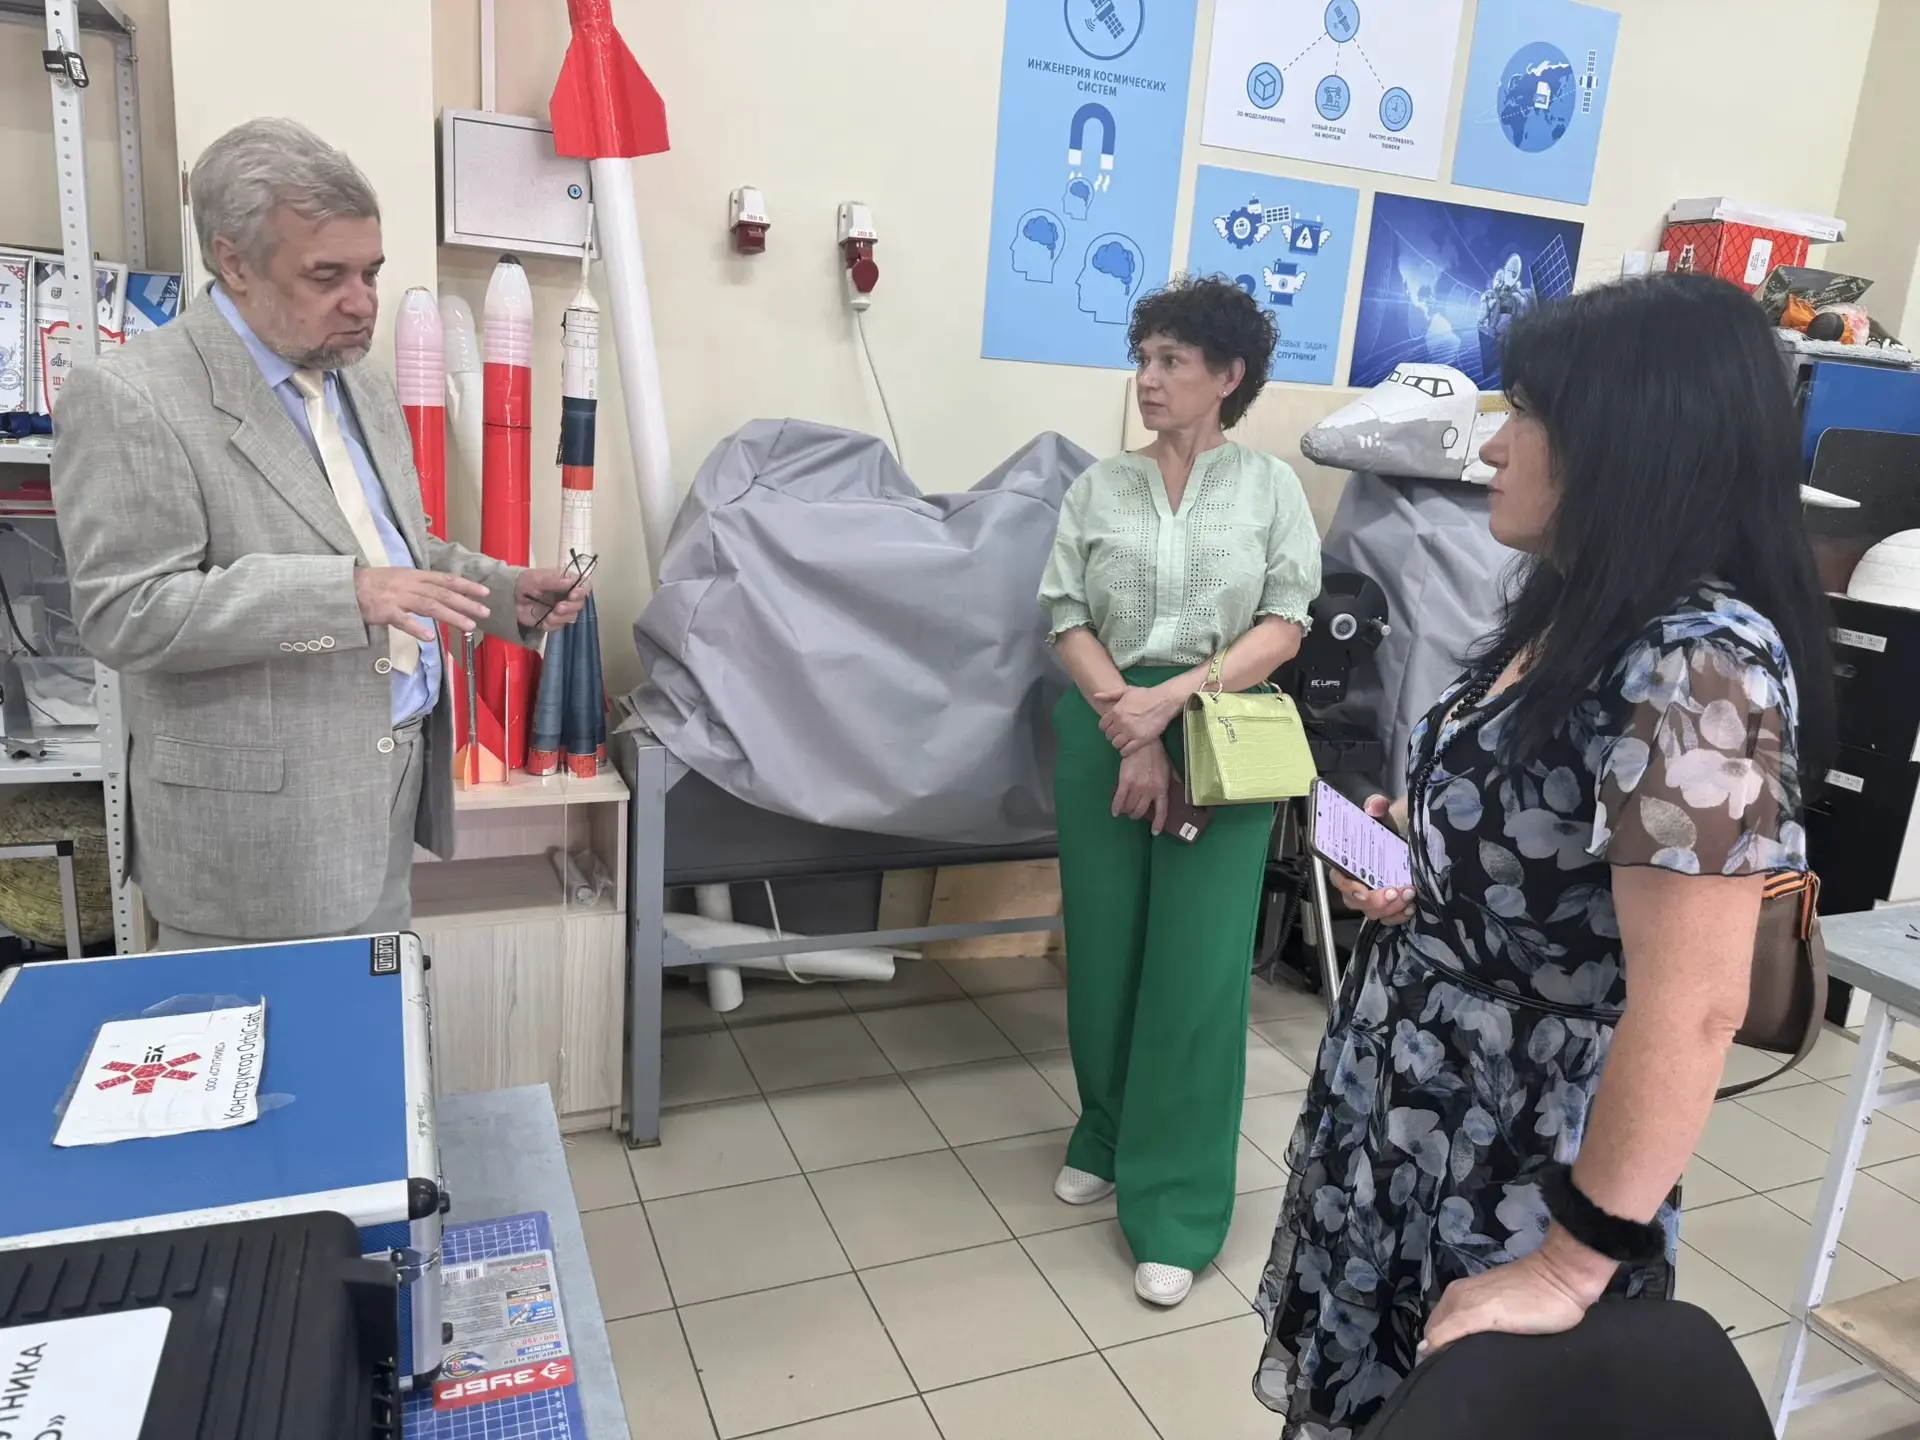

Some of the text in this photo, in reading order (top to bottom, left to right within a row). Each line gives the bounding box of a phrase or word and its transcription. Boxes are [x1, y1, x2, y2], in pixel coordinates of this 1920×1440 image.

[1027, 58, 1167, 92] ИНЖЕНЕРИЯ КОСМИЧЕСКИХ
[1077, 80, 1117, 97] СИСТЕМ
[1277, 351, 1316, 361] СПУТНИКИ
[375, 939, 396, 969] unipro
[223, 1009, 262, 1120] Конструктор OrbiCraft
[205, 1077, 218, 1092] ООО
[439, 1368, 537, 1400] ЗУБР
